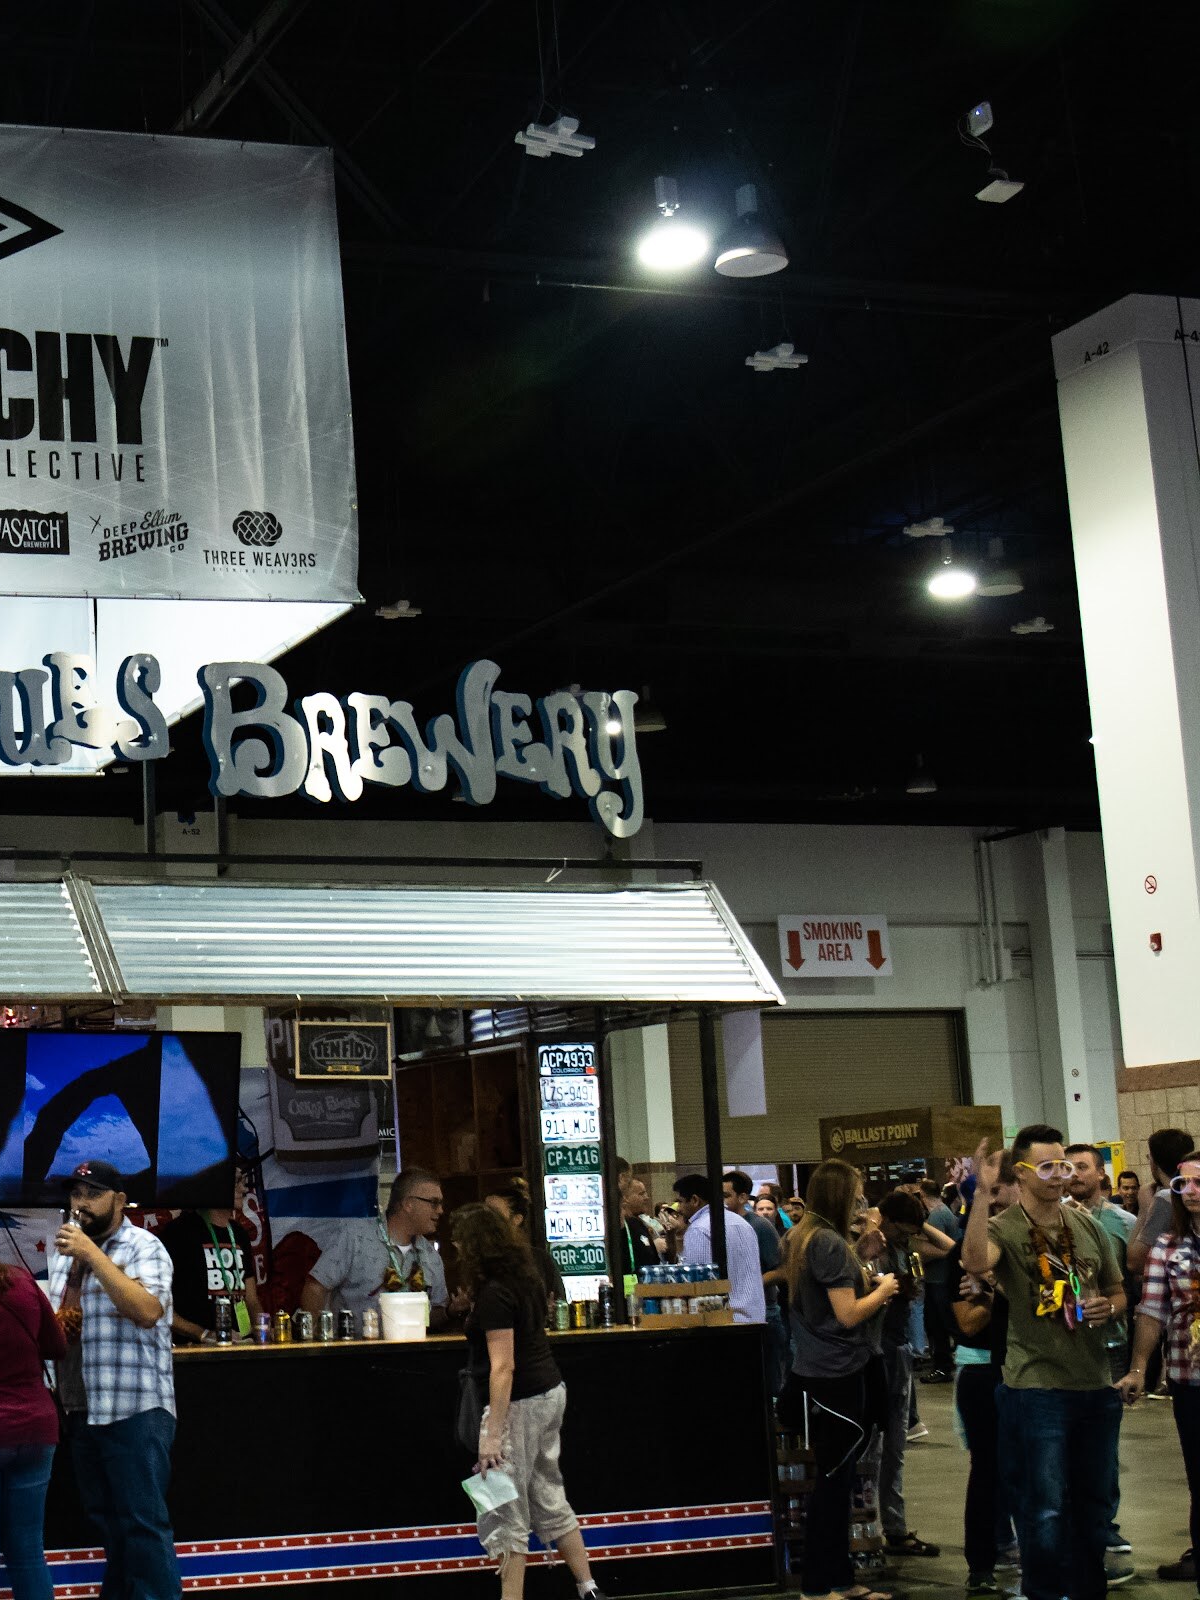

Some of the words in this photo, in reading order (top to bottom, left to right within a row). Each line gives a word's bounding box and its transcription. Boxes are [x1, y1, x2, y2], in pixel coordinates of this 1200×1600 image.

[1174, 329, 1200, 342] A-4
[1083, 341, 1110, 364] A-42
[103, 521, 137, 539] DEEP
[140, 508, 182, 530] Ellum
[23, 541, 50, 549] BREWERY
[98, 522, 190, 562] BREWING
[203, 550, 245, 566] THREE
[253, 551, 316, 567] WEAV3RS
[198, 658, 643, 838] BREWERY
[803, 921, 863, 940] SMOKING
[818, 943, 853, 961] AREA
[542, 1052, 593, 1068] ACP4933
[545, 1119, 567, 1135] 911
[573, 1118, 596, 1134] MJG
[844, 1126, 886, 1143] BALLAST
[887, 1122, 919, 1140] POINT
[550, 1217, 573, 1233] MGN
[578, 1216, 601, 1232] 751
[203, 1247, 244, 1269] HOT
[207, 1269, 246, 1291] BOX
